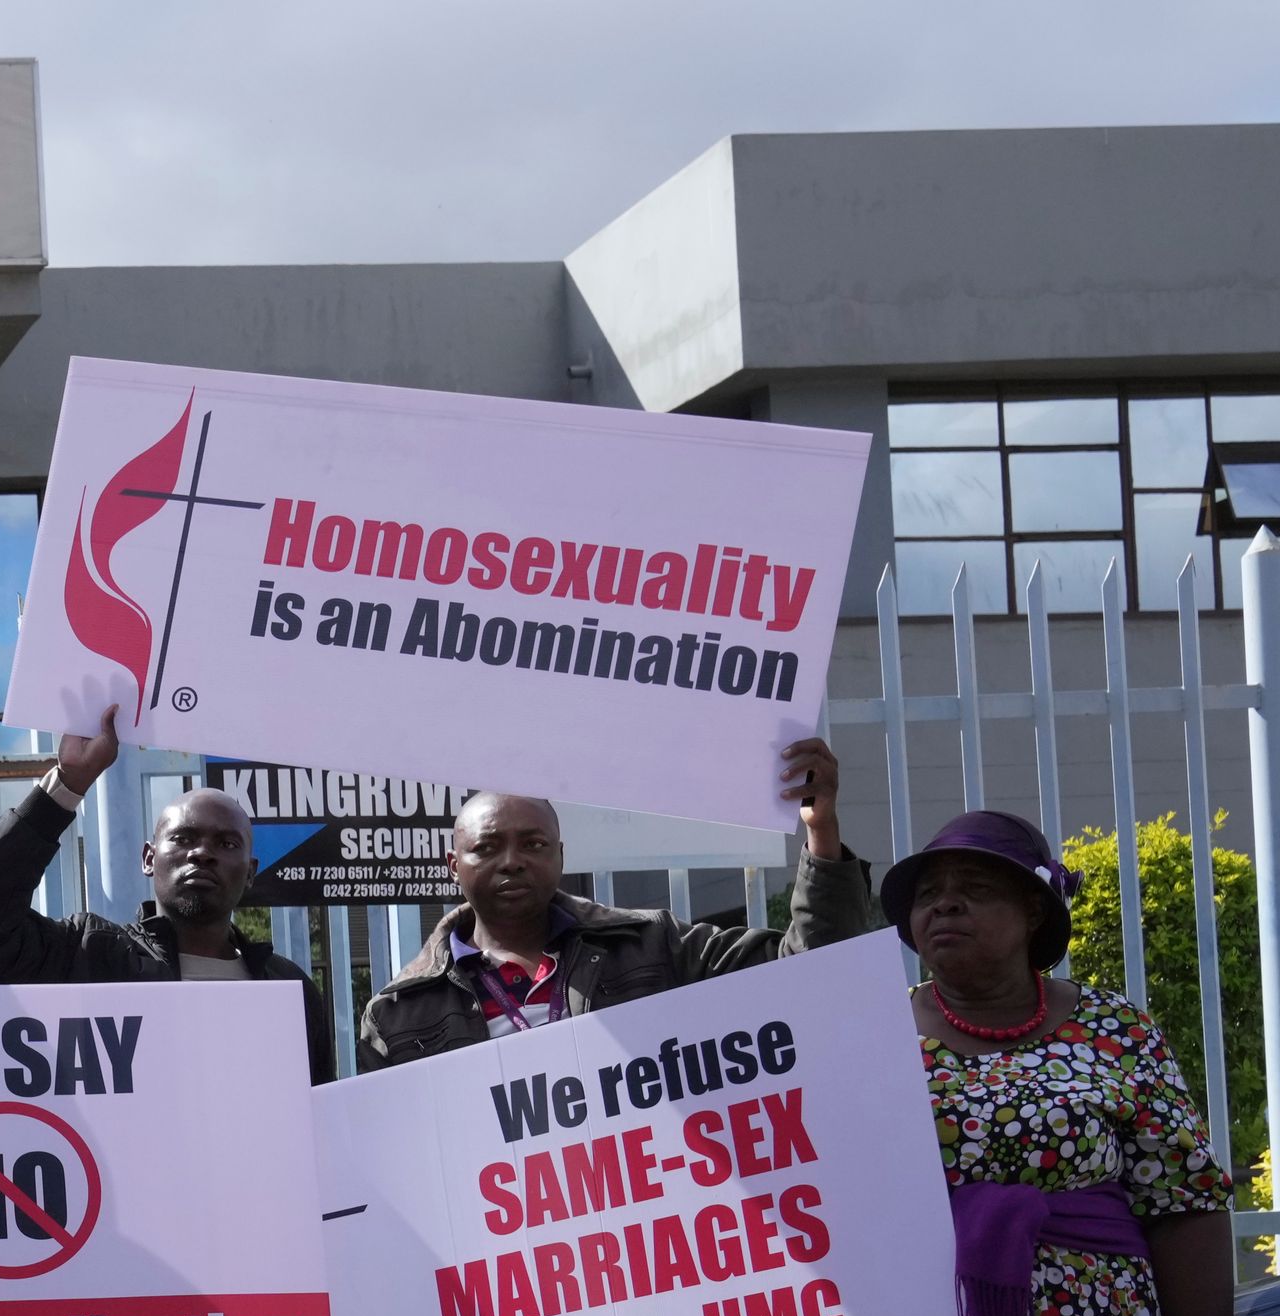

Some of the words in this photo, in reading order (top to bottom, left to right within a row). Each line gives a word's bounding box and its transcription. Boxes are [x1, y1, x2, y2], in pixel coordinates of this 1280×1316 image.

[263, 498, 816, 633] Homosexuality
[250, 579, 306, 641] is
[316, 597, 392, 652] an
[400, 597, 800, 703] Abomination
[276, 866, 306, 881] +263
[309, 866, 322, 880] 77
[323, 866, 346, 880] 230
[347, 866, 373, 880] 6511
[382, 865, 412, 879] +263
[413, 865, 426, 879] 71
[323, 883, 352, 898] 0242
[353, 883, 396, 897] 251059
[405, 882, 434, 897] 0242
[1, 1015, 143, 1098] SAY
[490, 1073, 587, 1144] We
[601, 1020, 797, 1118] refuse
[479, 1087, 819, 1236] SAME-SEX
